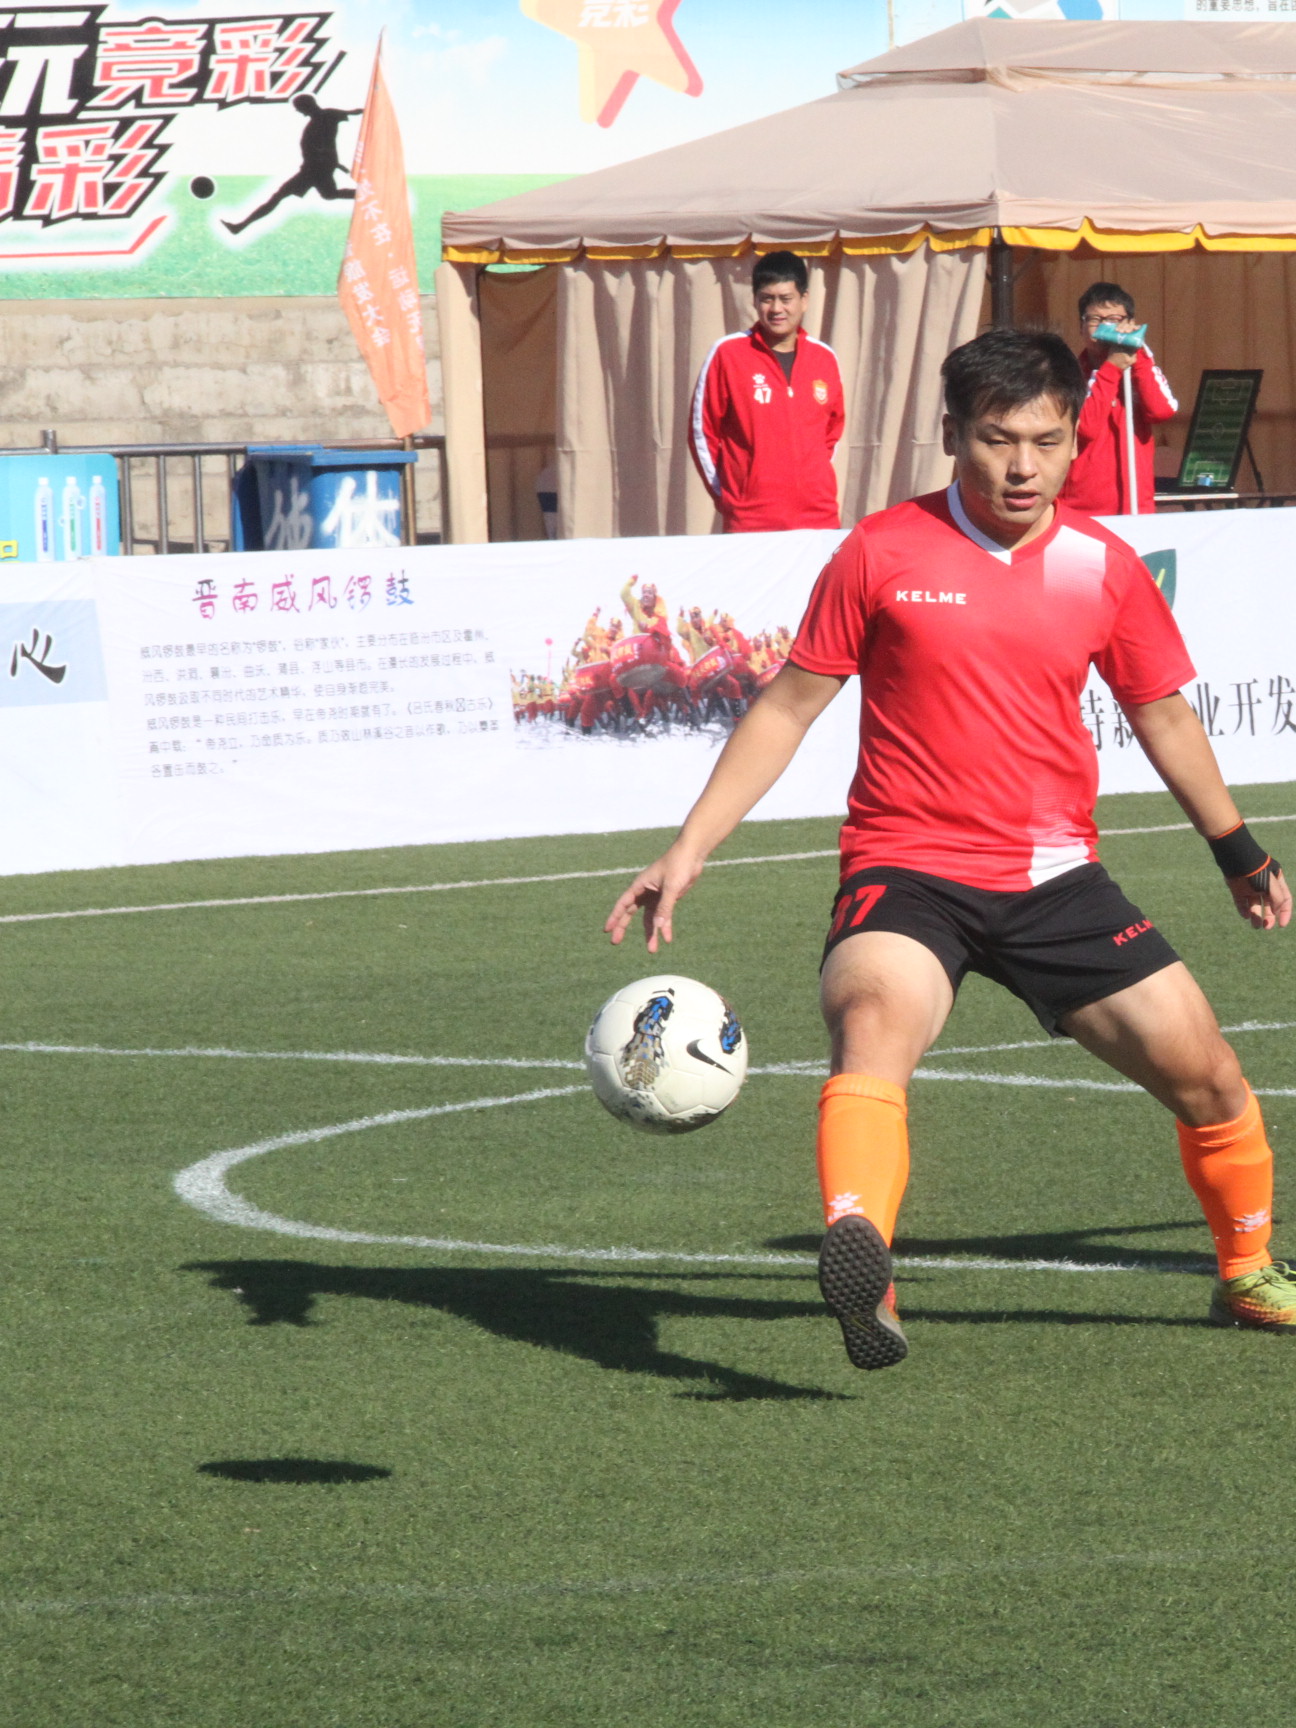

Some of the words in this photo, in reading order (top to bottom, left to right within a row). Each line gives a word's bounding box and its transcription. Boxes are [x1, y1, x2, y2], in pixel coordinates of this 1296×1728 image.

[896, 590, 967, 605] KELME
[9, 626, 67, 685] 心
[1112, 919, 1154, 947] KELM
